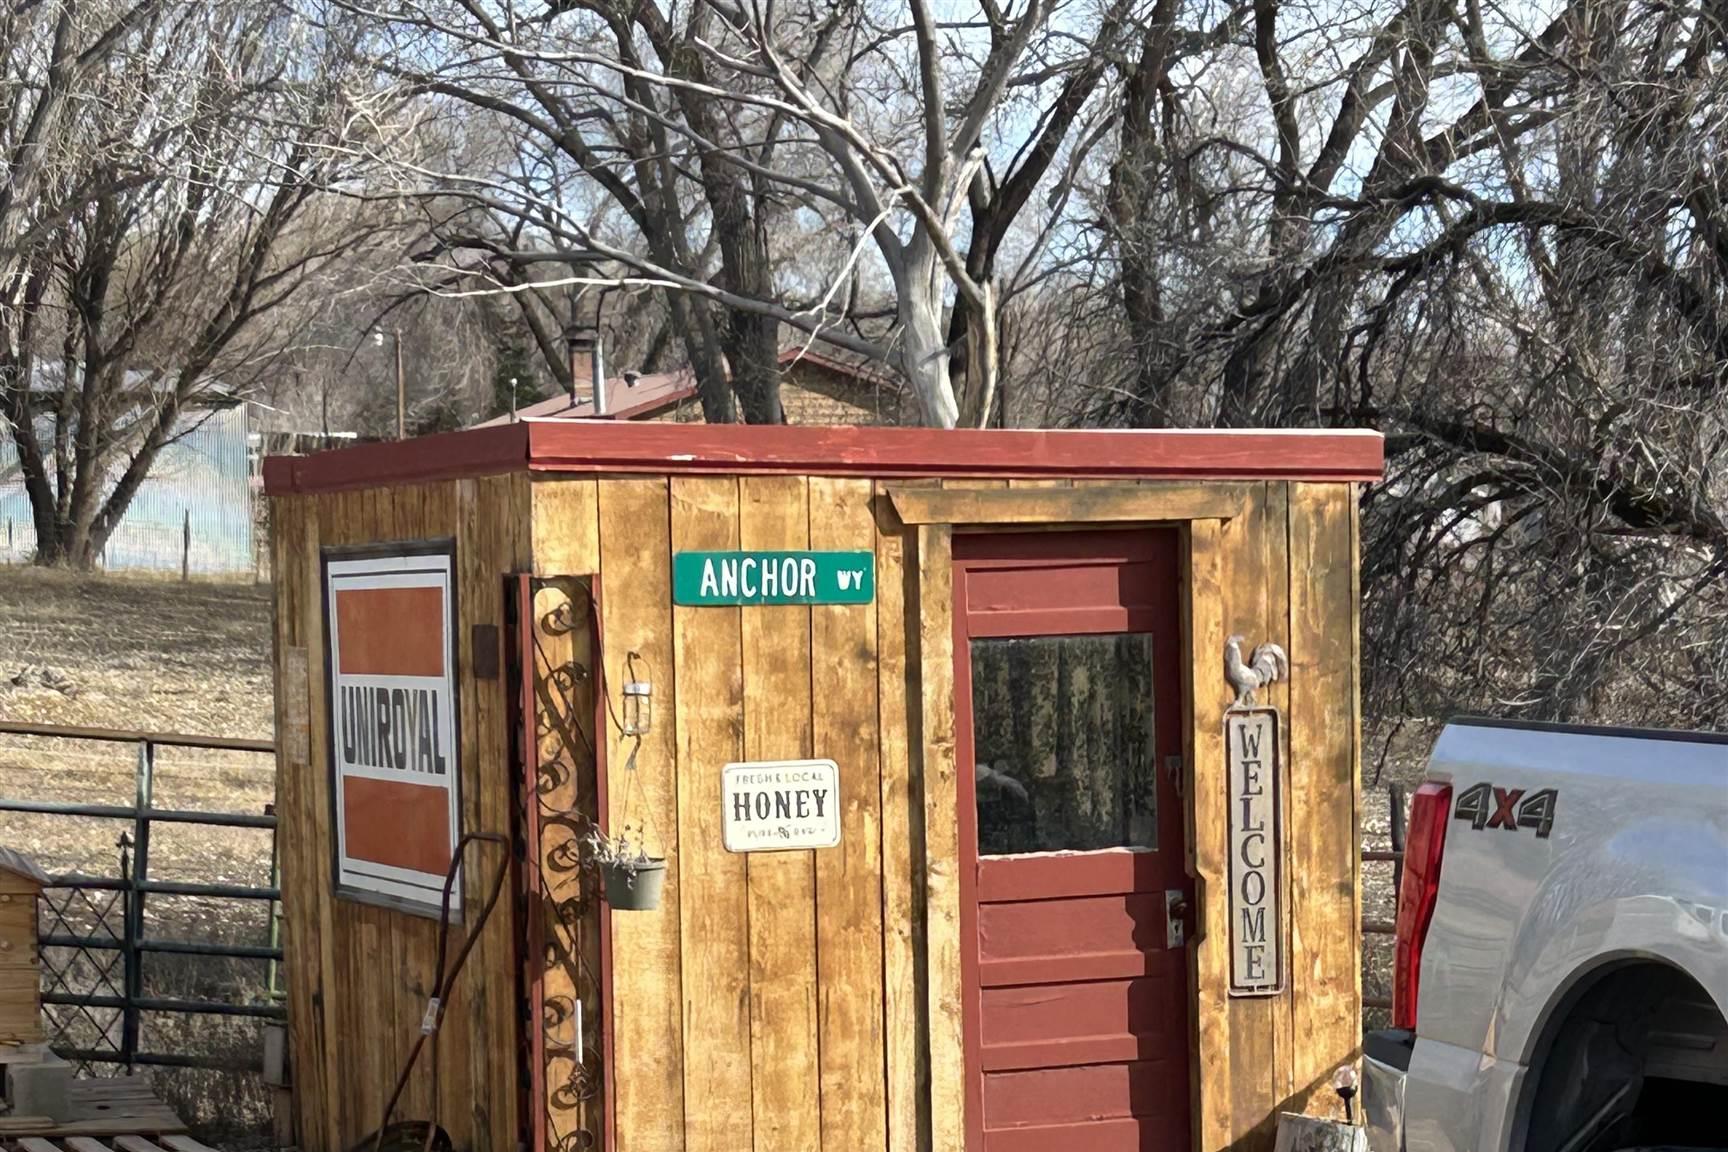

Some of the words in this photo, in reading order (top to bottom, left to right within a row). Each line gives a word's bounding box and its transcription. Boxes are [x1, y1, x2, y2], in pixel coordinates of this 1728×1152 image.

[700, 557, 816, 598] ANCHOR
[836, 569, 864, 591] WY
[341, 685, 446, 776] UNIROYAL
[784, 772, 825, 783] LOCAL
[732, 789, 829, 822] HONEY
[1238, 723, 1267, 981] WELCOME
